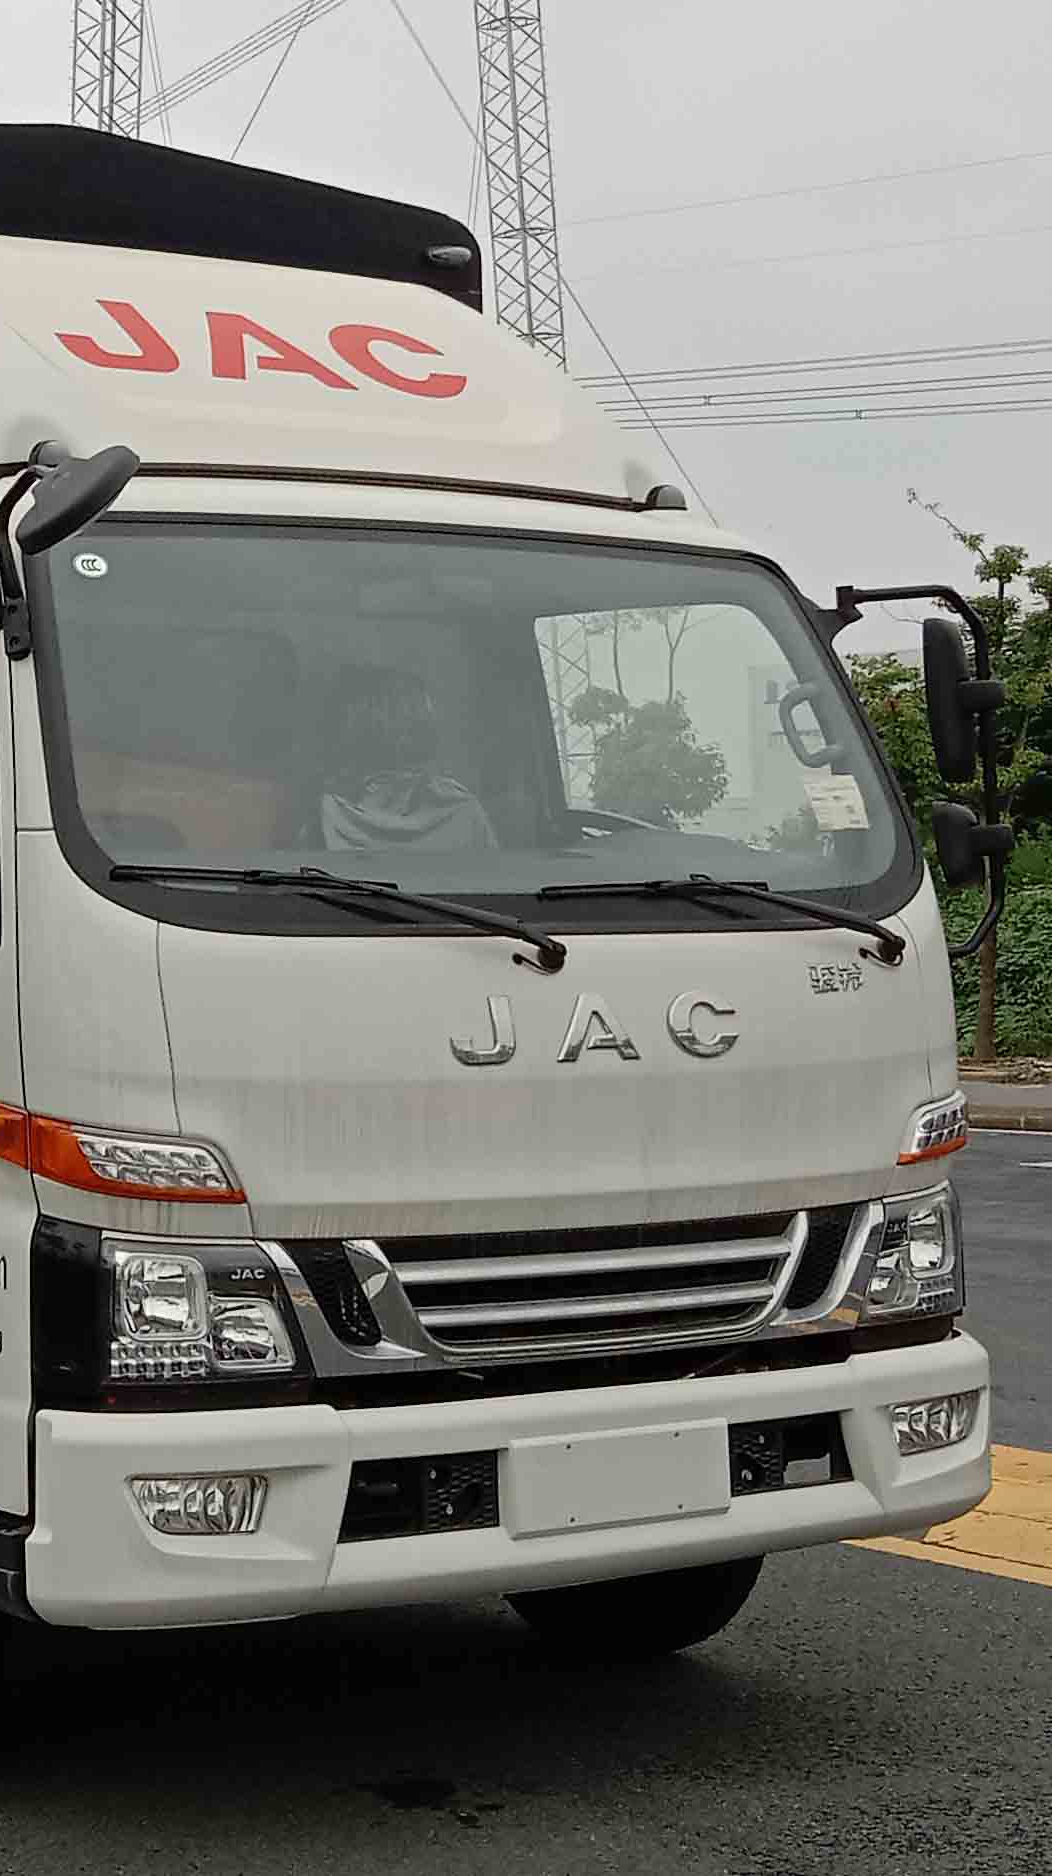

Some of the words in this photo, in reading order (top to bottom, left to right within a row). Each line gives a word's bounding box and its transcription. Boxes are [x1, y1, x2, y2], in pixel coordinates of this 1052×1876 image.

[55, 299, 467, 398] JAC
[450, 991, 739, 1066] JAC
[230, 1268, 267, 1280] JAC
